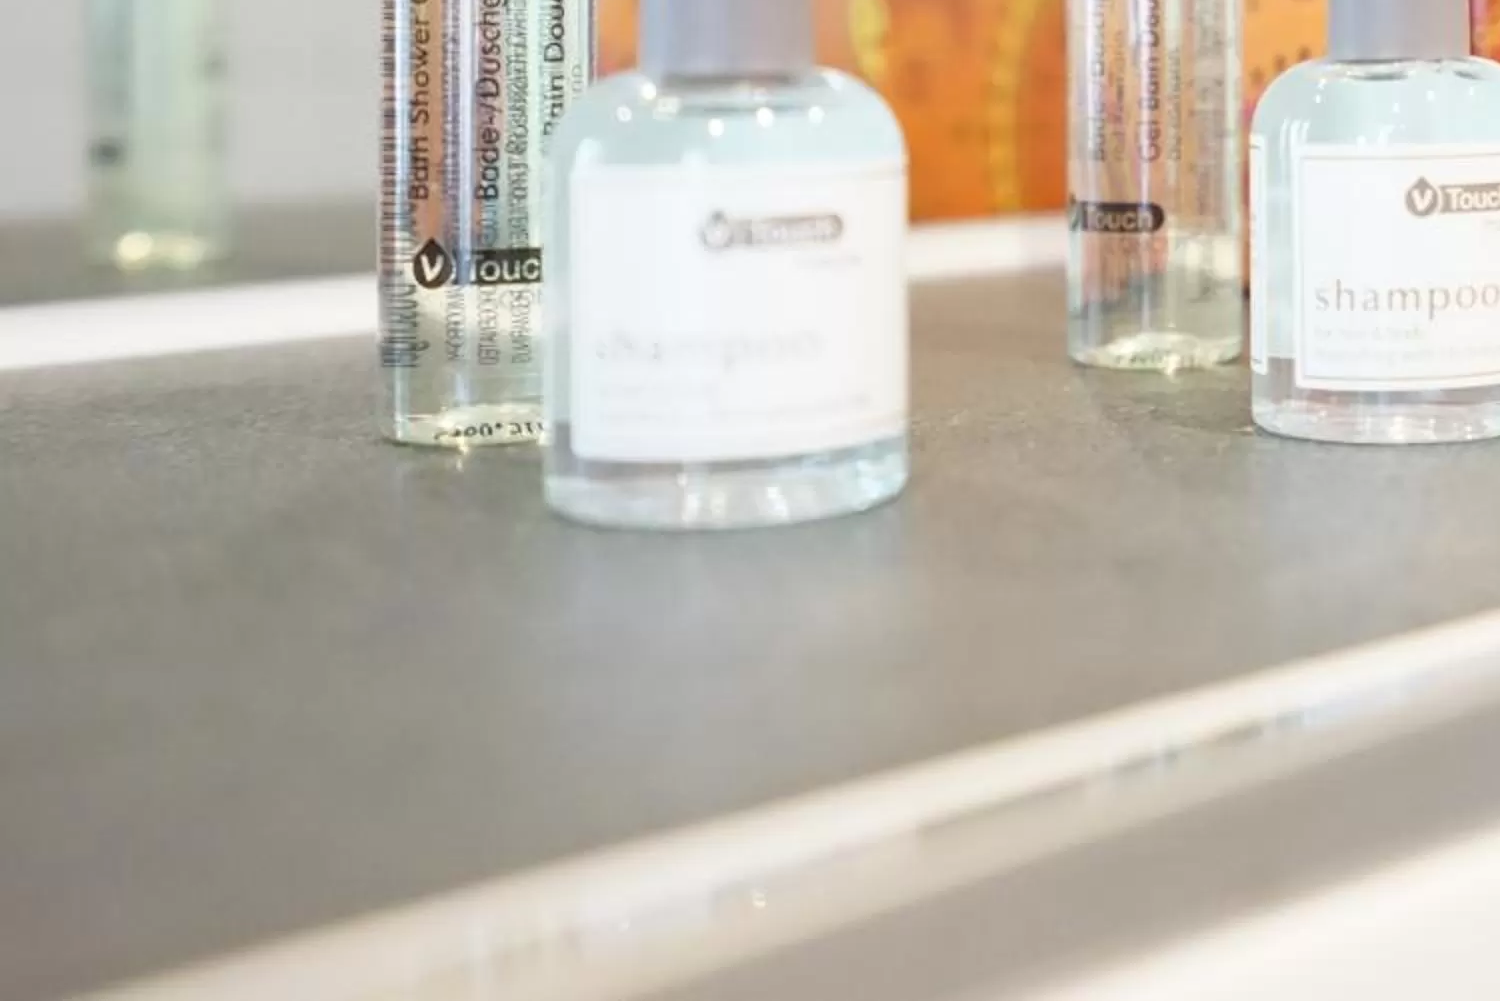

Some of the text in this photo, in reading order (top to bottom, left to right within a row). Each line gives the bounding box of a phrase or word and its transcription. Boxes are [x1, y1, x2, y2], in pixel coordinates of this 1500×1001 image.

[410, 18, 430, 125] Shower
[410, 136, 429, 199] Bath
[469, 255, 541, 282] Touc
